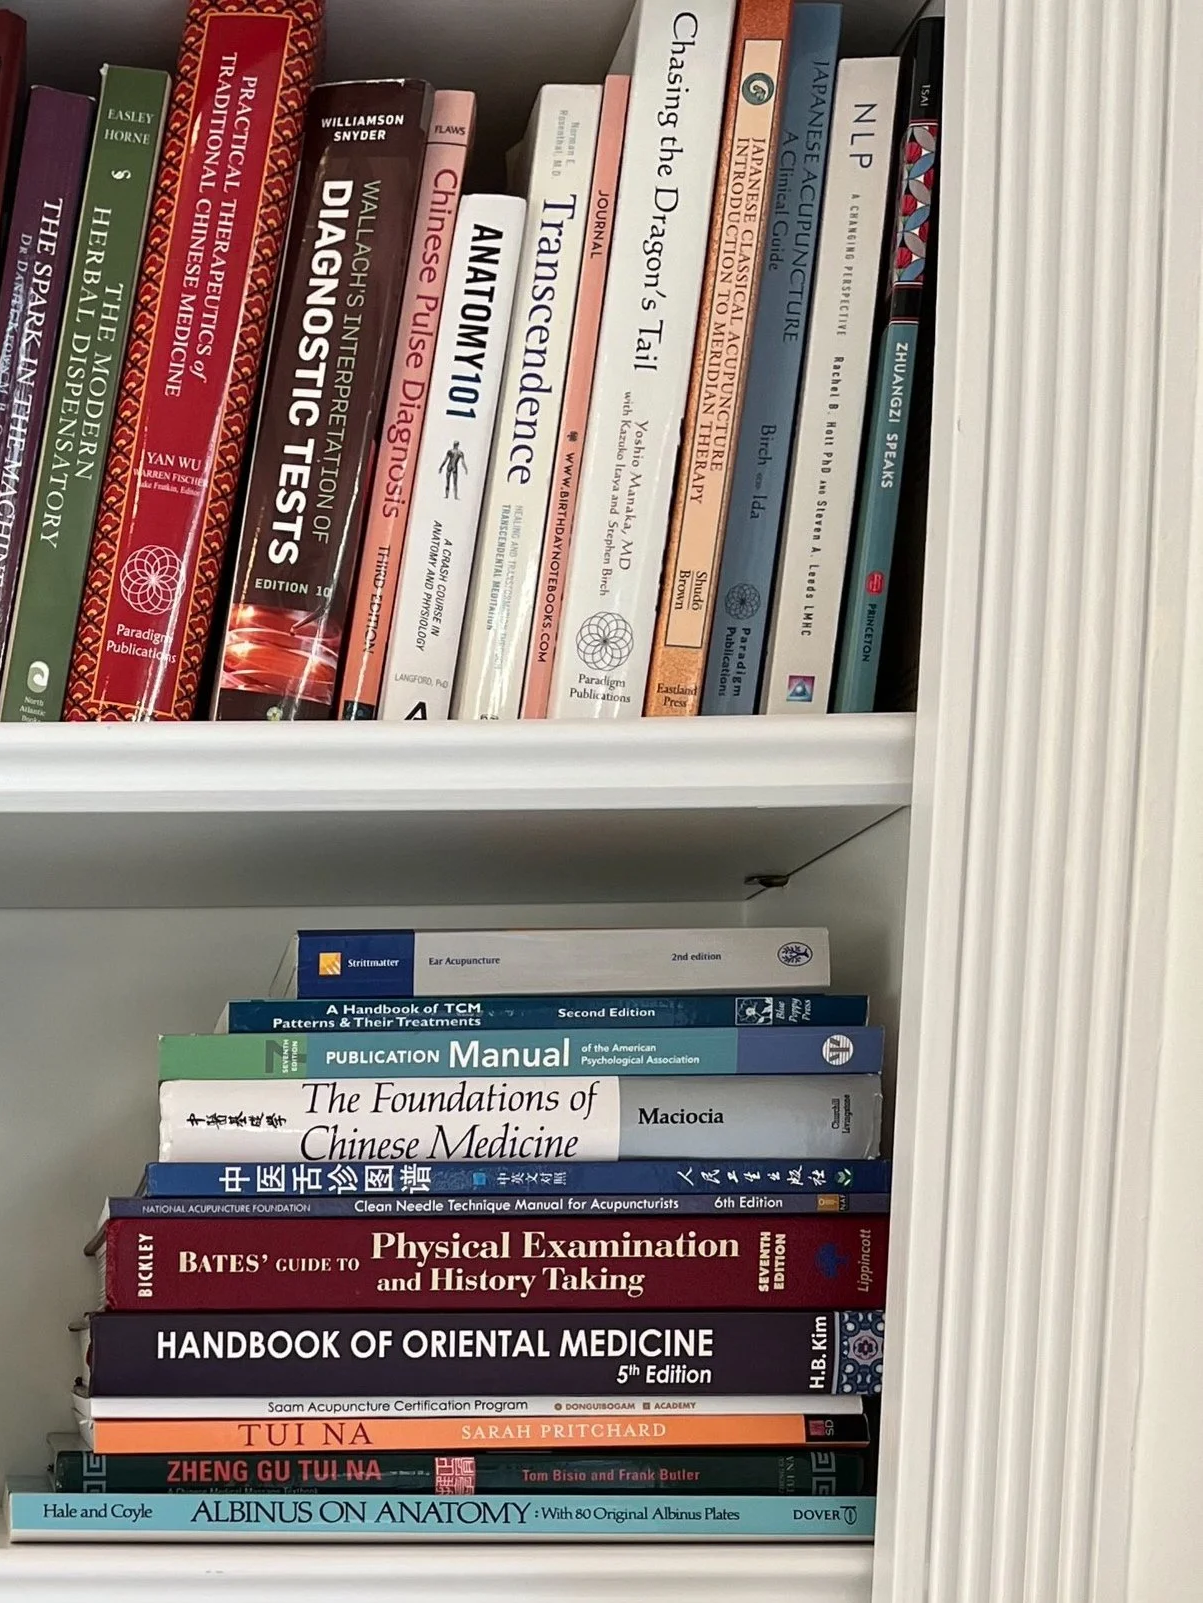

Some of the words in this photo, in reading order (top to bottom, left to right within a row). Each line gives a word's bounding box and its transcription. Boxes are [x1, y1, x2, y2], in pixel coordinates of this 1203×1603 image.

[656, 11, 698, 128] Chasing
[321, 114, 404, 128] WILLIAMSON
[333, 129, 386, 142] SNYDER
[848, 102, 878, 168] NLP
[656, 135, 684, 177] the
[589, 189, 609, 259] JOURNAL
[640, 186, 679, 311] Dragon's
[288, 179, 353, 427] DIAGNOSTIC
[445, 223, 503, 418] ANATOMY101
[506, 193, 577, 484] Transcendence
[632, 318, 664, 370] Tail
[887, 341, 908, 422] ZHUANGZI
[880, 432, 898, 488] SPEAKS
[267, 437, 315, 564] TESTS
[537, 451, 575, 662] WWW.BIRTHDAYNOTEBOOKS.COM
[861, 603, 877, 662] PRINCETON
[347, 958, 399, 967] Strittmatter
[428, 956, 443, 966] Ear
[444, 956, 500, 967] Acupuncture
[670, 951, 688, 961] 2nd
[690, 952, 722, 961] edition
[272, 1017, 335, 1028] Patterns
[338, 1016, 351, 1028] &
[352, 1016, 394, 1027] Their
[394, 1016, 481, 1027] Treatments
[325, 1003, 338, 1015] A
[342, 1003, 419, 1014] Handbook
[422, 1002, 439, 1014] of
[443, 1002, 481, 1013] TCM
[557, 1007, 605, 1018] Second
[609, 1006, 655, 1017] Edition
[325, 1049, 440, 1064] PUBLICATION
[448, 1037, 569, 1068] Manual
[580, 1042, 592, 1052] of
[593, 1042, 609, 1052] the
[611, 1042, 656, 1052] American
[580, 1054, 644, 1067] Psychological
[645, 1054, 700, 1064] Association
[637, 1106, 724, 1124] Maciocia
[218, 1162, 436, 1195] 中医舌诊图谱
[370, 1230, 510, 1266] Physical
[522, 1230, 739, 1258] Examination
[137, 1232, 153, 1297] BICKLEY
[156, 1330, 340, 1359] HANDBOOK
[350, 1329, 392, 1358] OF
[402, 1329, 550, 1358] ORIENTAL
[558, 1328, 713, 1357] MEDICINE
[237, 1422, 304, 1446] TUI
[322, 1421, 373, 1445] NA
[461, 1424, 530, 1439] SARAH
[540, 1422, 666, 1438] PRITCHARD
[189, 1499, 313, 1523] ALBINUS
[318, 1500, 367, 1523] ON
[373, 1500, 531, 1524] ANATOMY
[792, 1508, 840, 1520] DOVER
